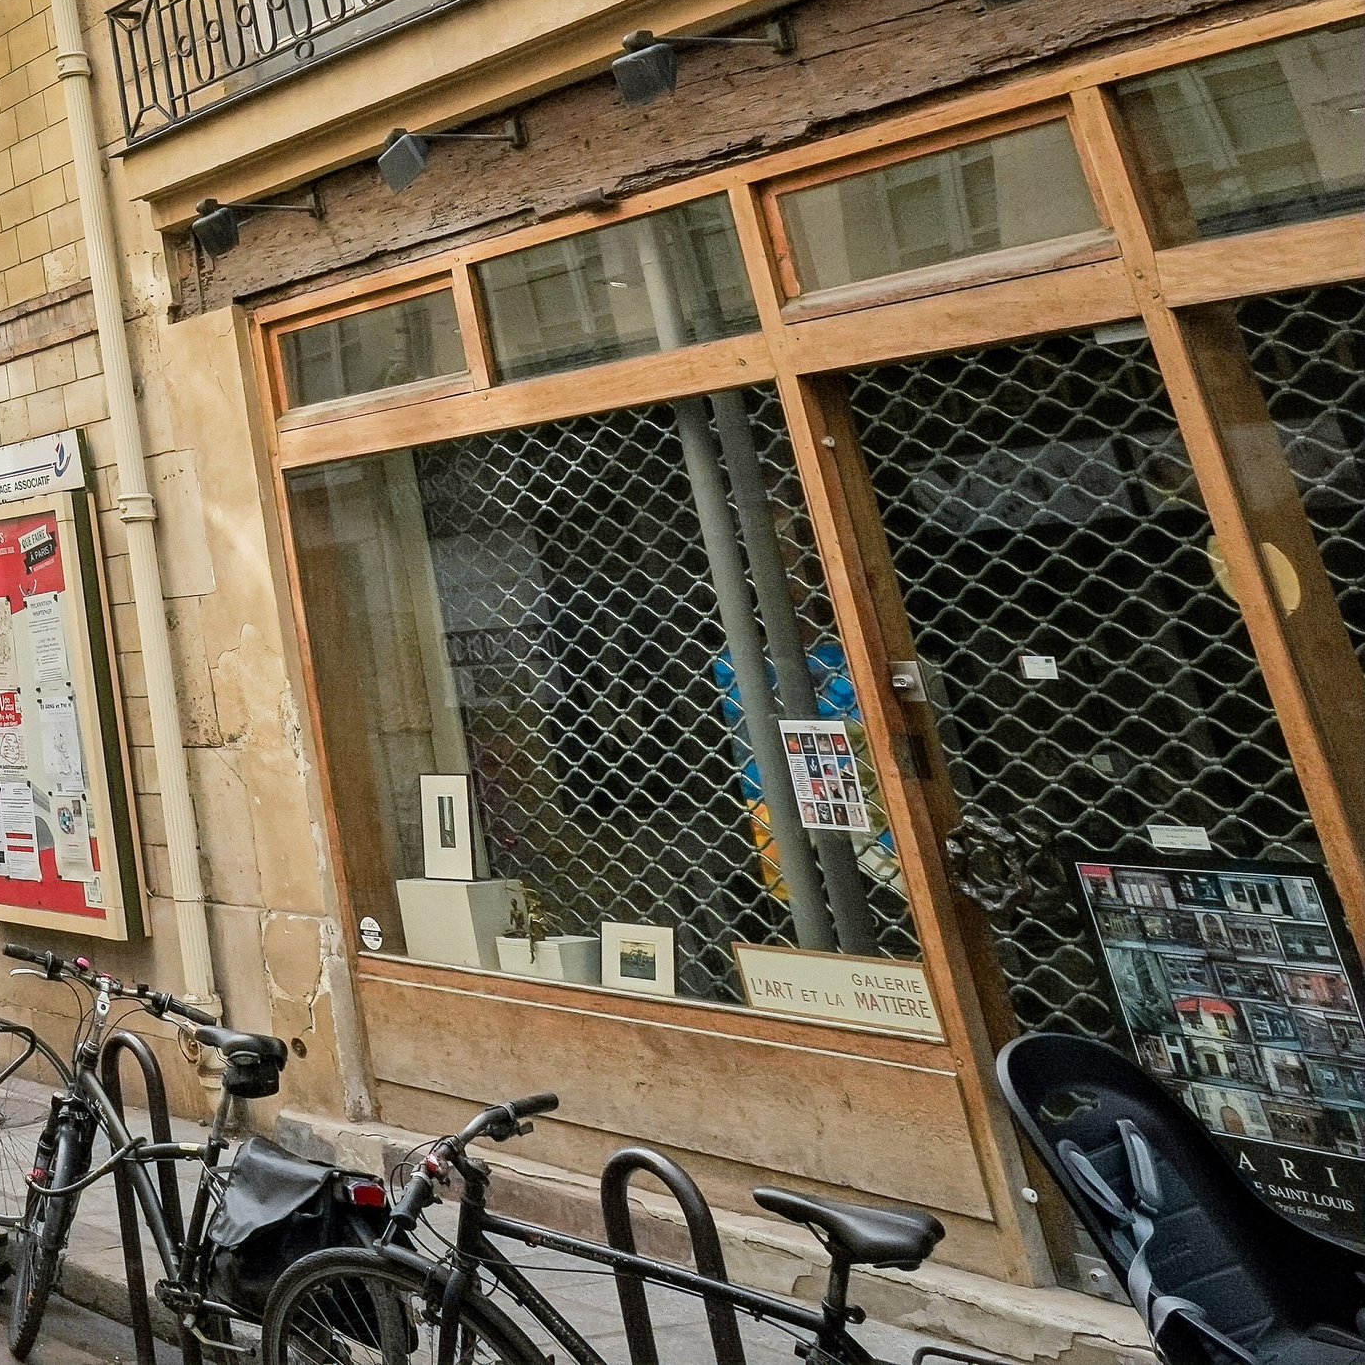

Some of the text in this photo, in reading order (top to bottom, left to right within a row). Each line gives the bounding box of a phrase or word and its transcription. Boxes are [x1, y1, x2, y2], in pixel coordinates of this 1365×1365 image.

[14, 475, 50, 491] ASSOCIATIF
[21, 529, 46, 550] QUE FAIRE
[35, 545, 50, 560] PARIS
[851, 974, 923, 994] GALERIE
[750, 978, 932, 1019] L'ART ET LA MATIERE
[1268, 1184, 1309, 1203] SAINT
[1312, 1192, 1355, 1212] LOUIS
[1297, 1206, 1330, 1221] Editions
